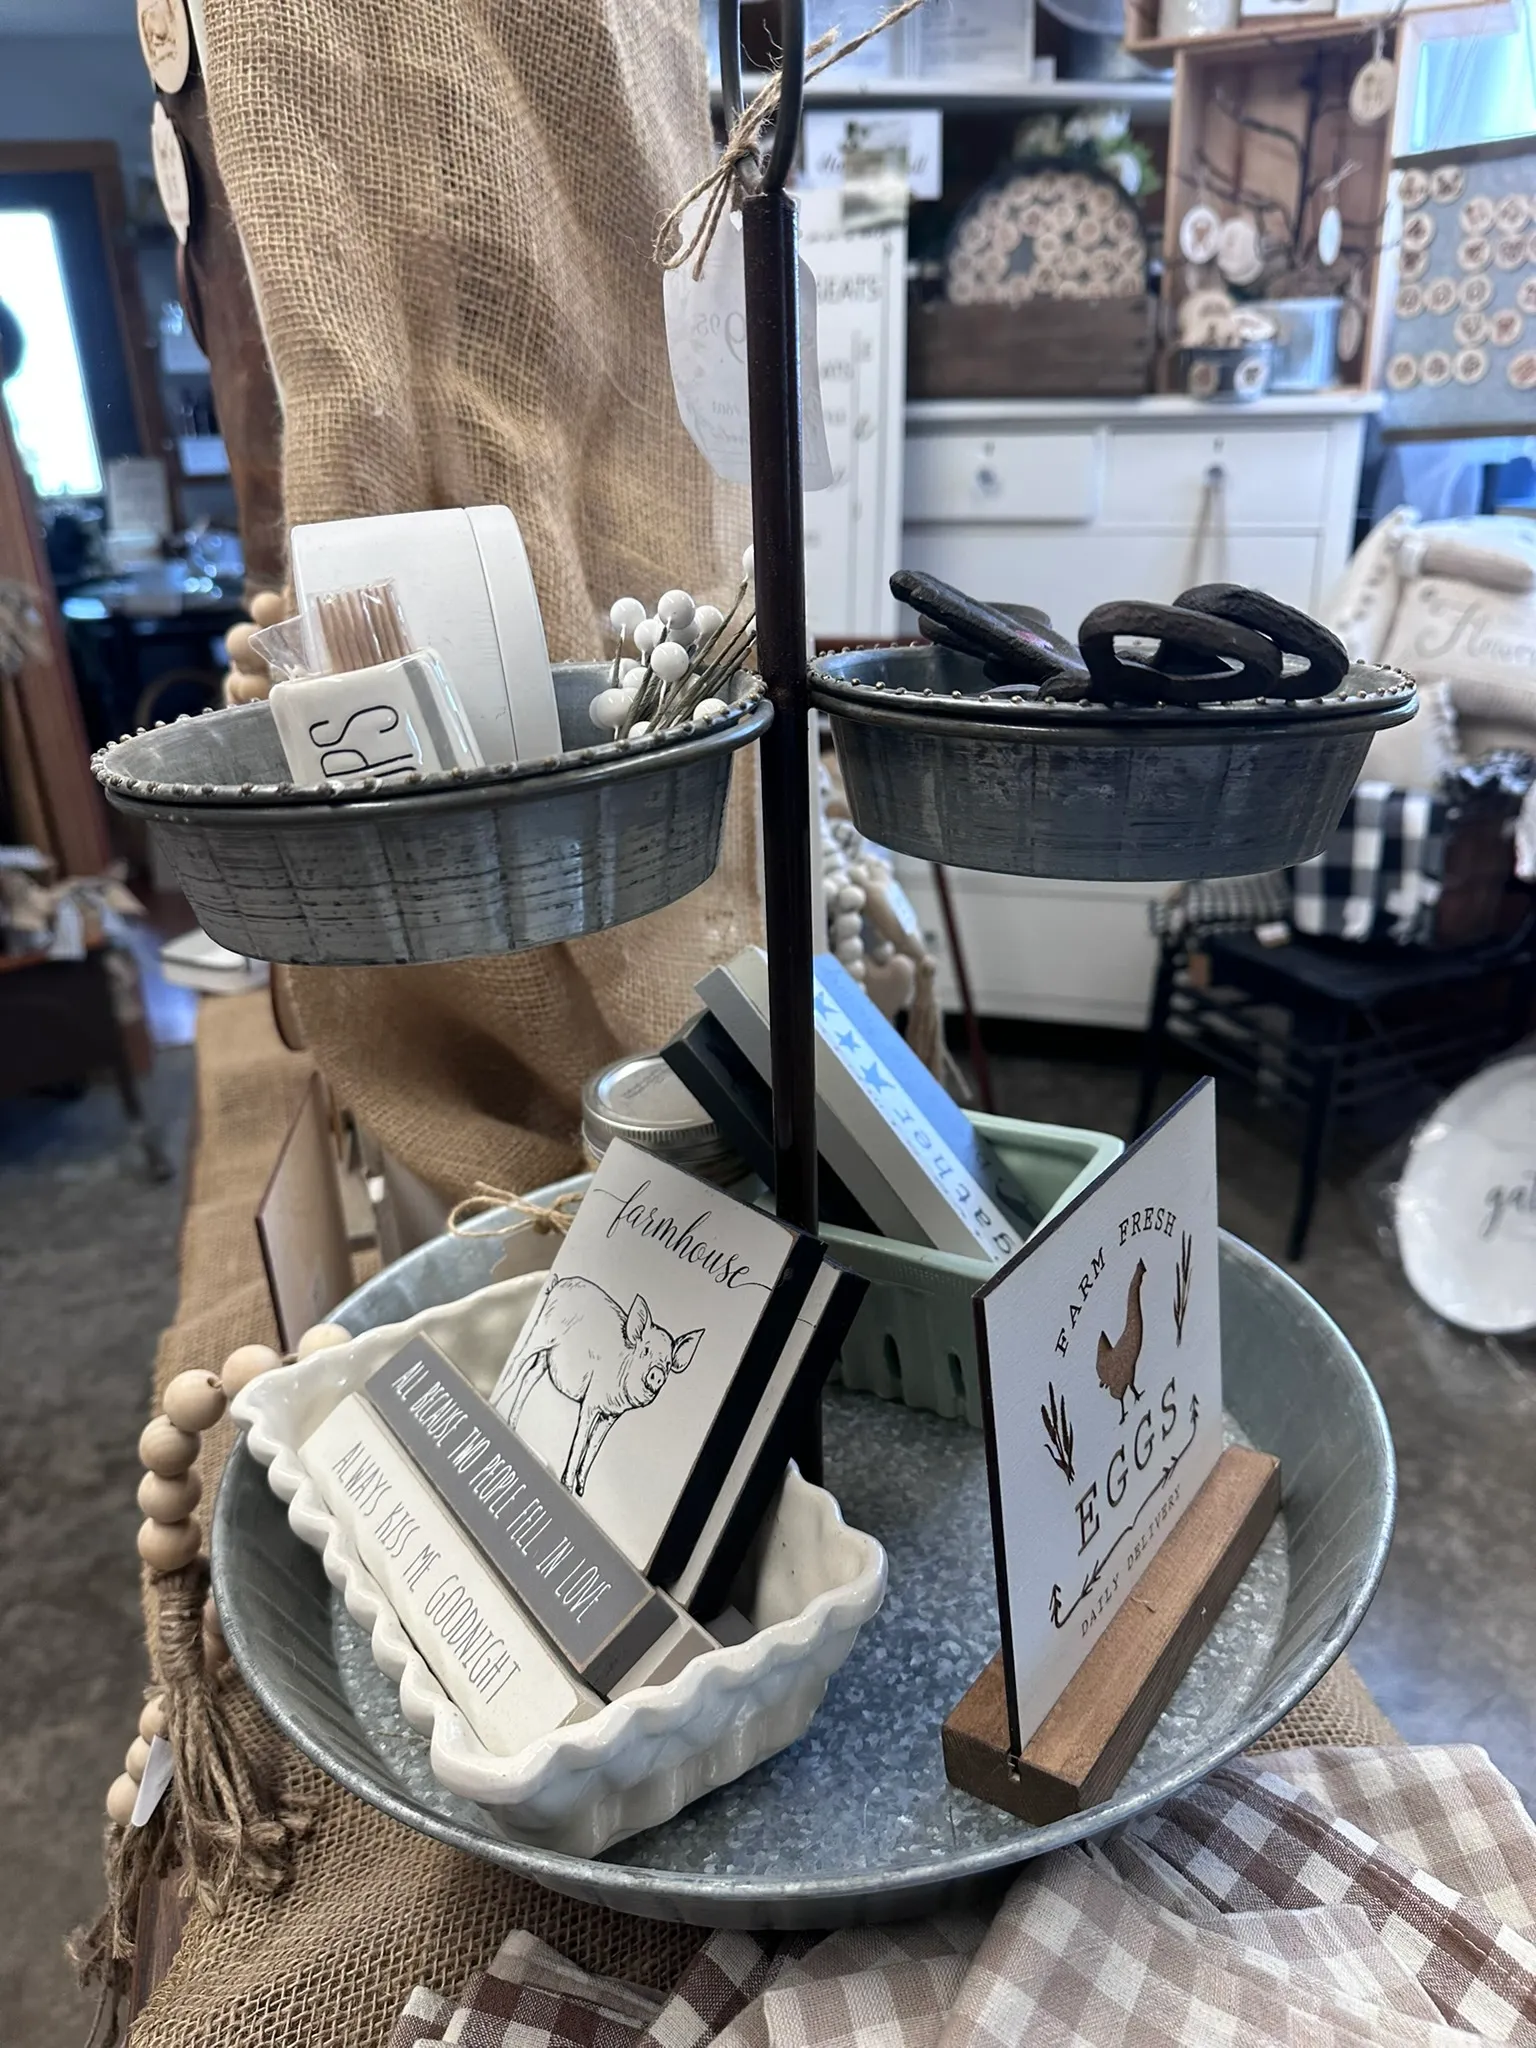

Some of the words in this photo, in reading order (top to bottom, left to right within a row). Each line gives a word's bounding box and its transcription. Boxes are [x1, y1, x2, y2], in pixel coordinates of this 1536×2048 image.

[309, 705, 417, 779] PS
[893, 1106, 1017, 1256] gather
[593, 1179, 773, 1292] farmhouse
[1055, 1246, 1106, 1358] FARM
[1118, 1207, 1177, 1247] FRESH
[391, 1360, 430, 1401] ALL
[409, 1381, 469, 1448] BECAUSE
[447, 1426, 491, 1474] TWO
[1074, 1376, 1178, 1557] EGGS
[468, 1453, 527, 1519] PEOPLE
[506, 1498, 553, 1556] FELL
[535, 1536, 575, 1579] IN
[1081, 1573, 1120, 1638] DAILY
[1126, 1483, 1182, 1572] DELIVERY
[332, 1440, 393, 1517] ALWAYS
[374, 1501, 421, 1558] KISS
[402, 1543, 442, 1593] ME
[424, 1574, 522, 1705] GOODNIGHT
[555, 1558, 612, 1624] LOVE
